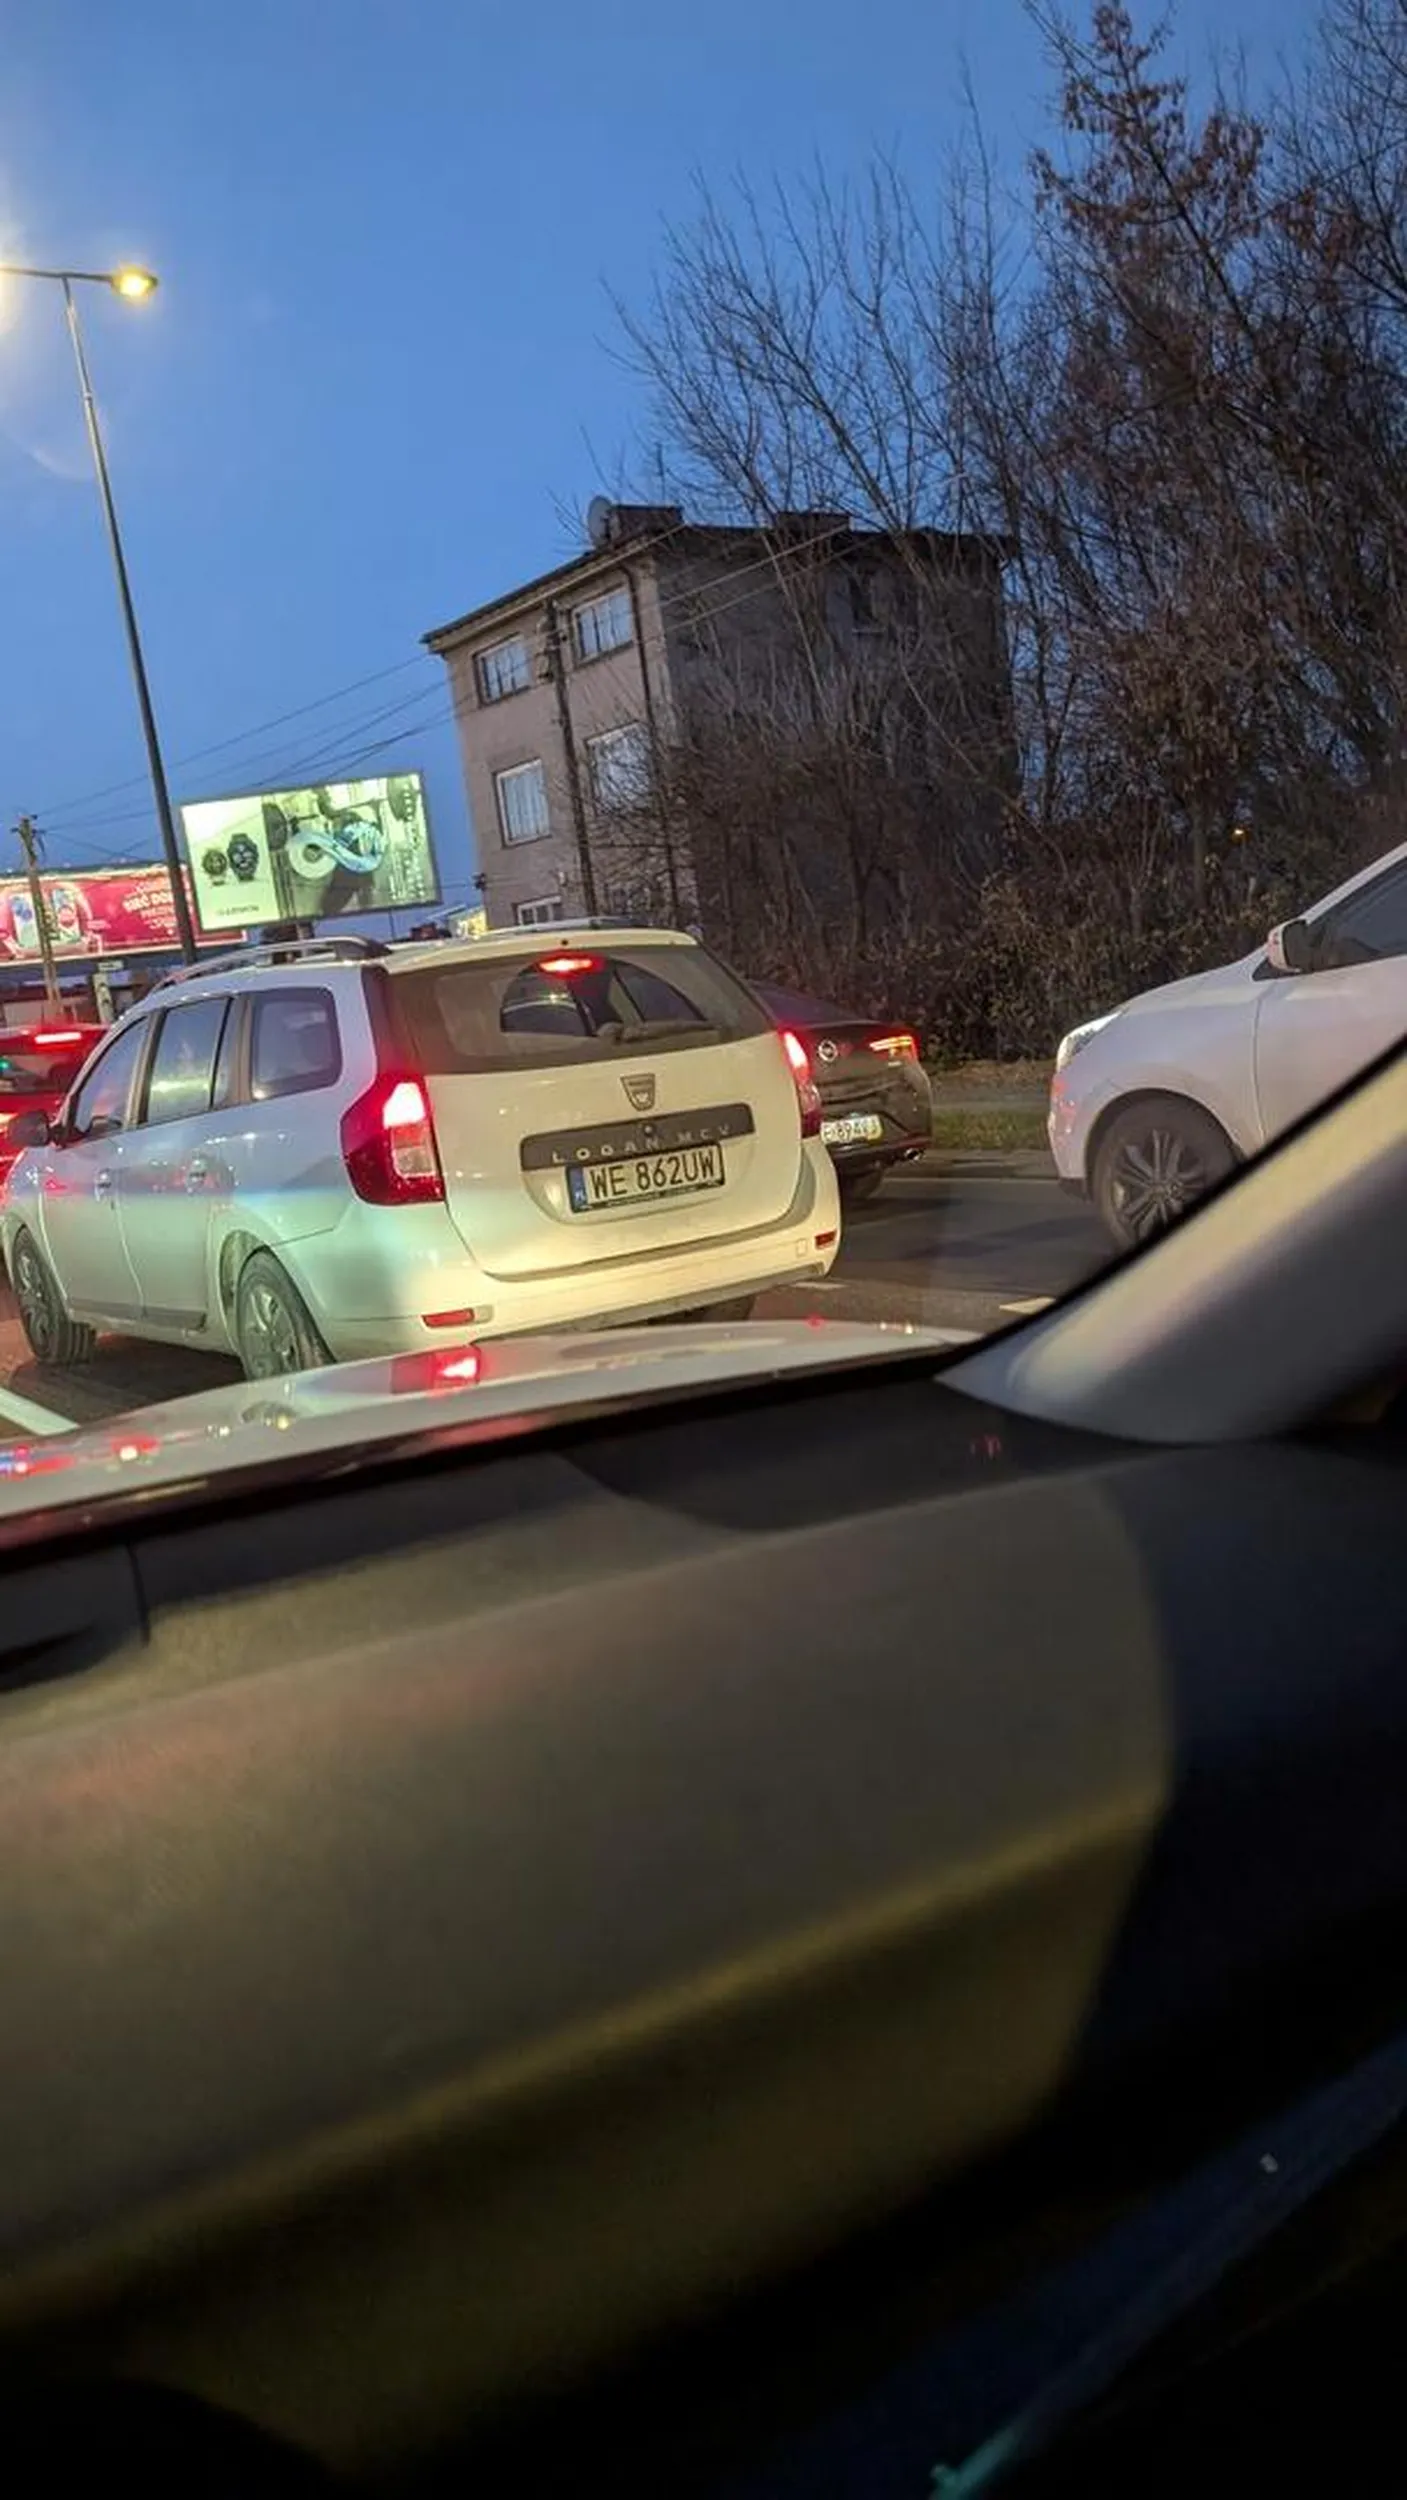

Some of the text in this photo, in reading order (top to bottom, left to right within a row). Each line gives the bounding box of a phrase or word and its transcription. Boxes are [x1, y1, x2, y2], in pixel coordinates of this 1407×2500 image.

[552, 1123, 731, 1164] LOGAN MCV
[590, 1152, 715, 1200] WE 862UW
